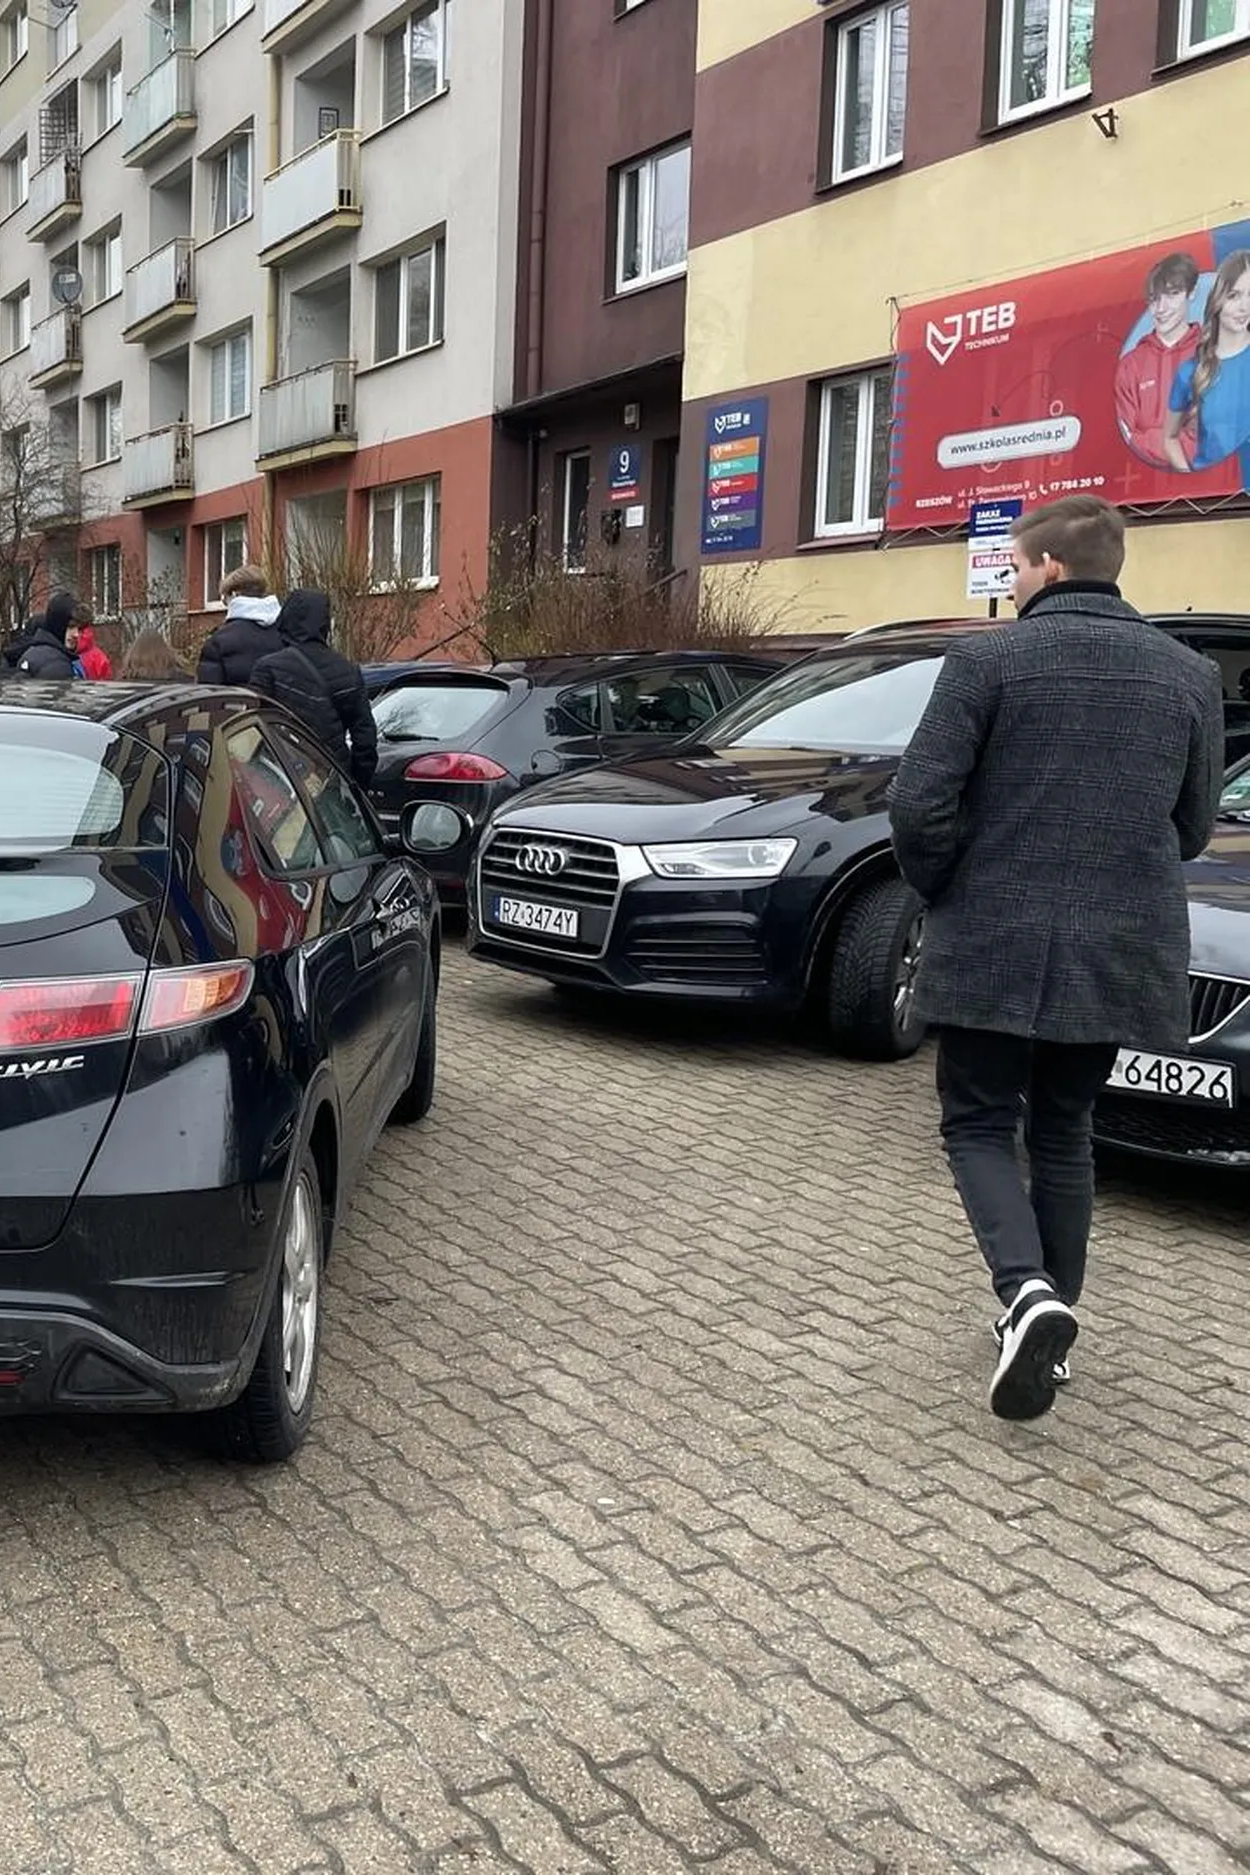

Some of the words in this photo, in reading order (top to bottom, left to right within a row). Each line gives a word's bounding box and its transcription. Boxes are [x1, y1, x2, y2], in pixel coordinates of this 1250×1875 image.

[966, 301, 1016, 336] TEB
[950, 425, 1066, 455] www.szkolasrednia.pl
[619, 450, 630, 473] 9
[975, 554, 1011, 567] UWAGA
[503, 900, 521, 925] RZ
[525, 904, 574, 935] 3474Y
[1124, 1054, 1228, 1100] 64826
